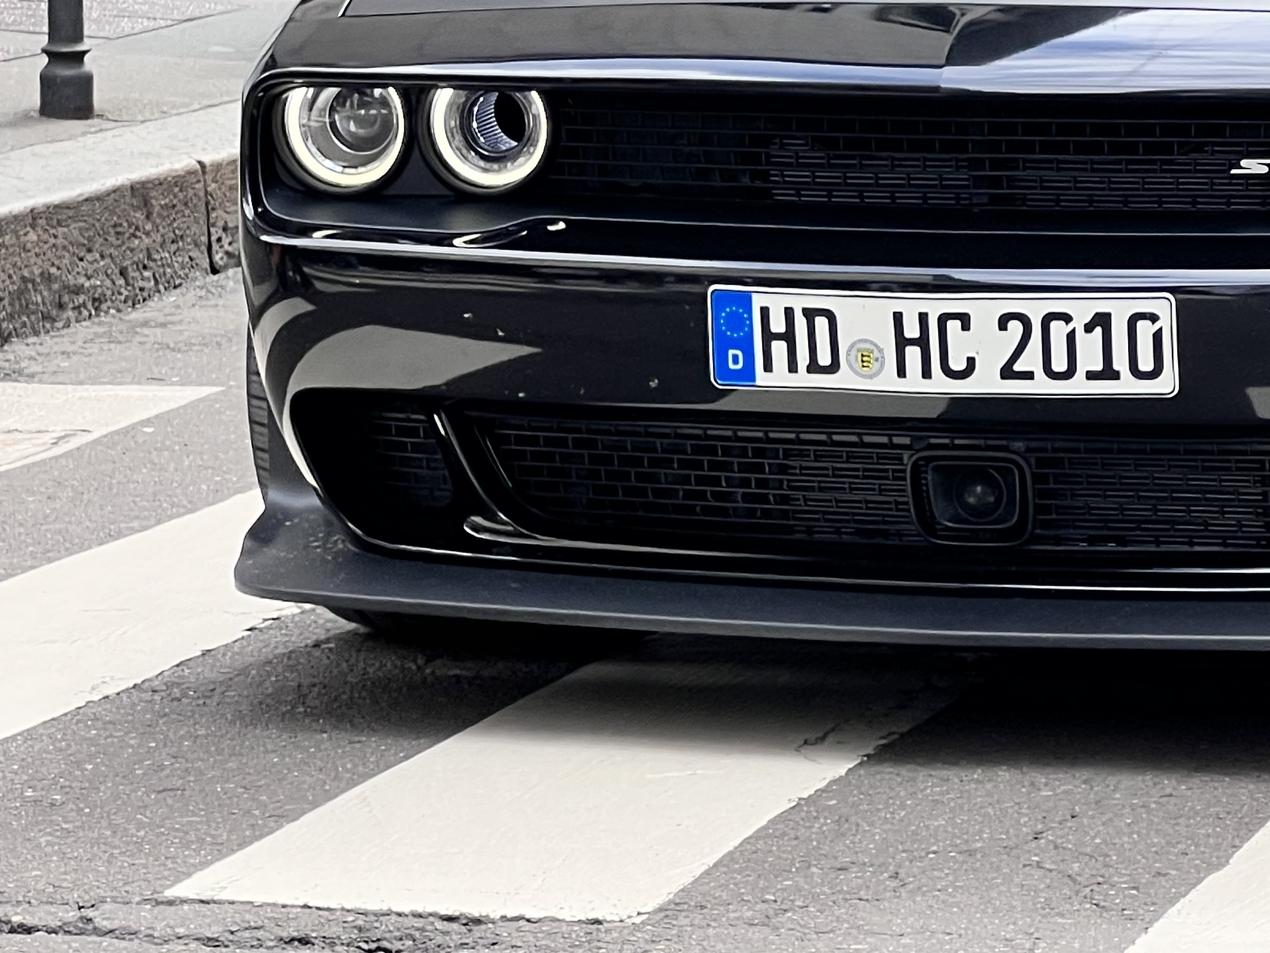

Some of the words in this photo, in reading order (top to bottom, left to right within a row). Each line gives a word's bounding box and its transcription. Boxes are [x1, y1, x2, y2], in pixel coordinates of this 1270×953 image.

[728, 349, 744, 370] D
[759, 305, 841, 375] HD
[892, 311, 978, 380] HC
[999, 311, 1165, 381] 2010
